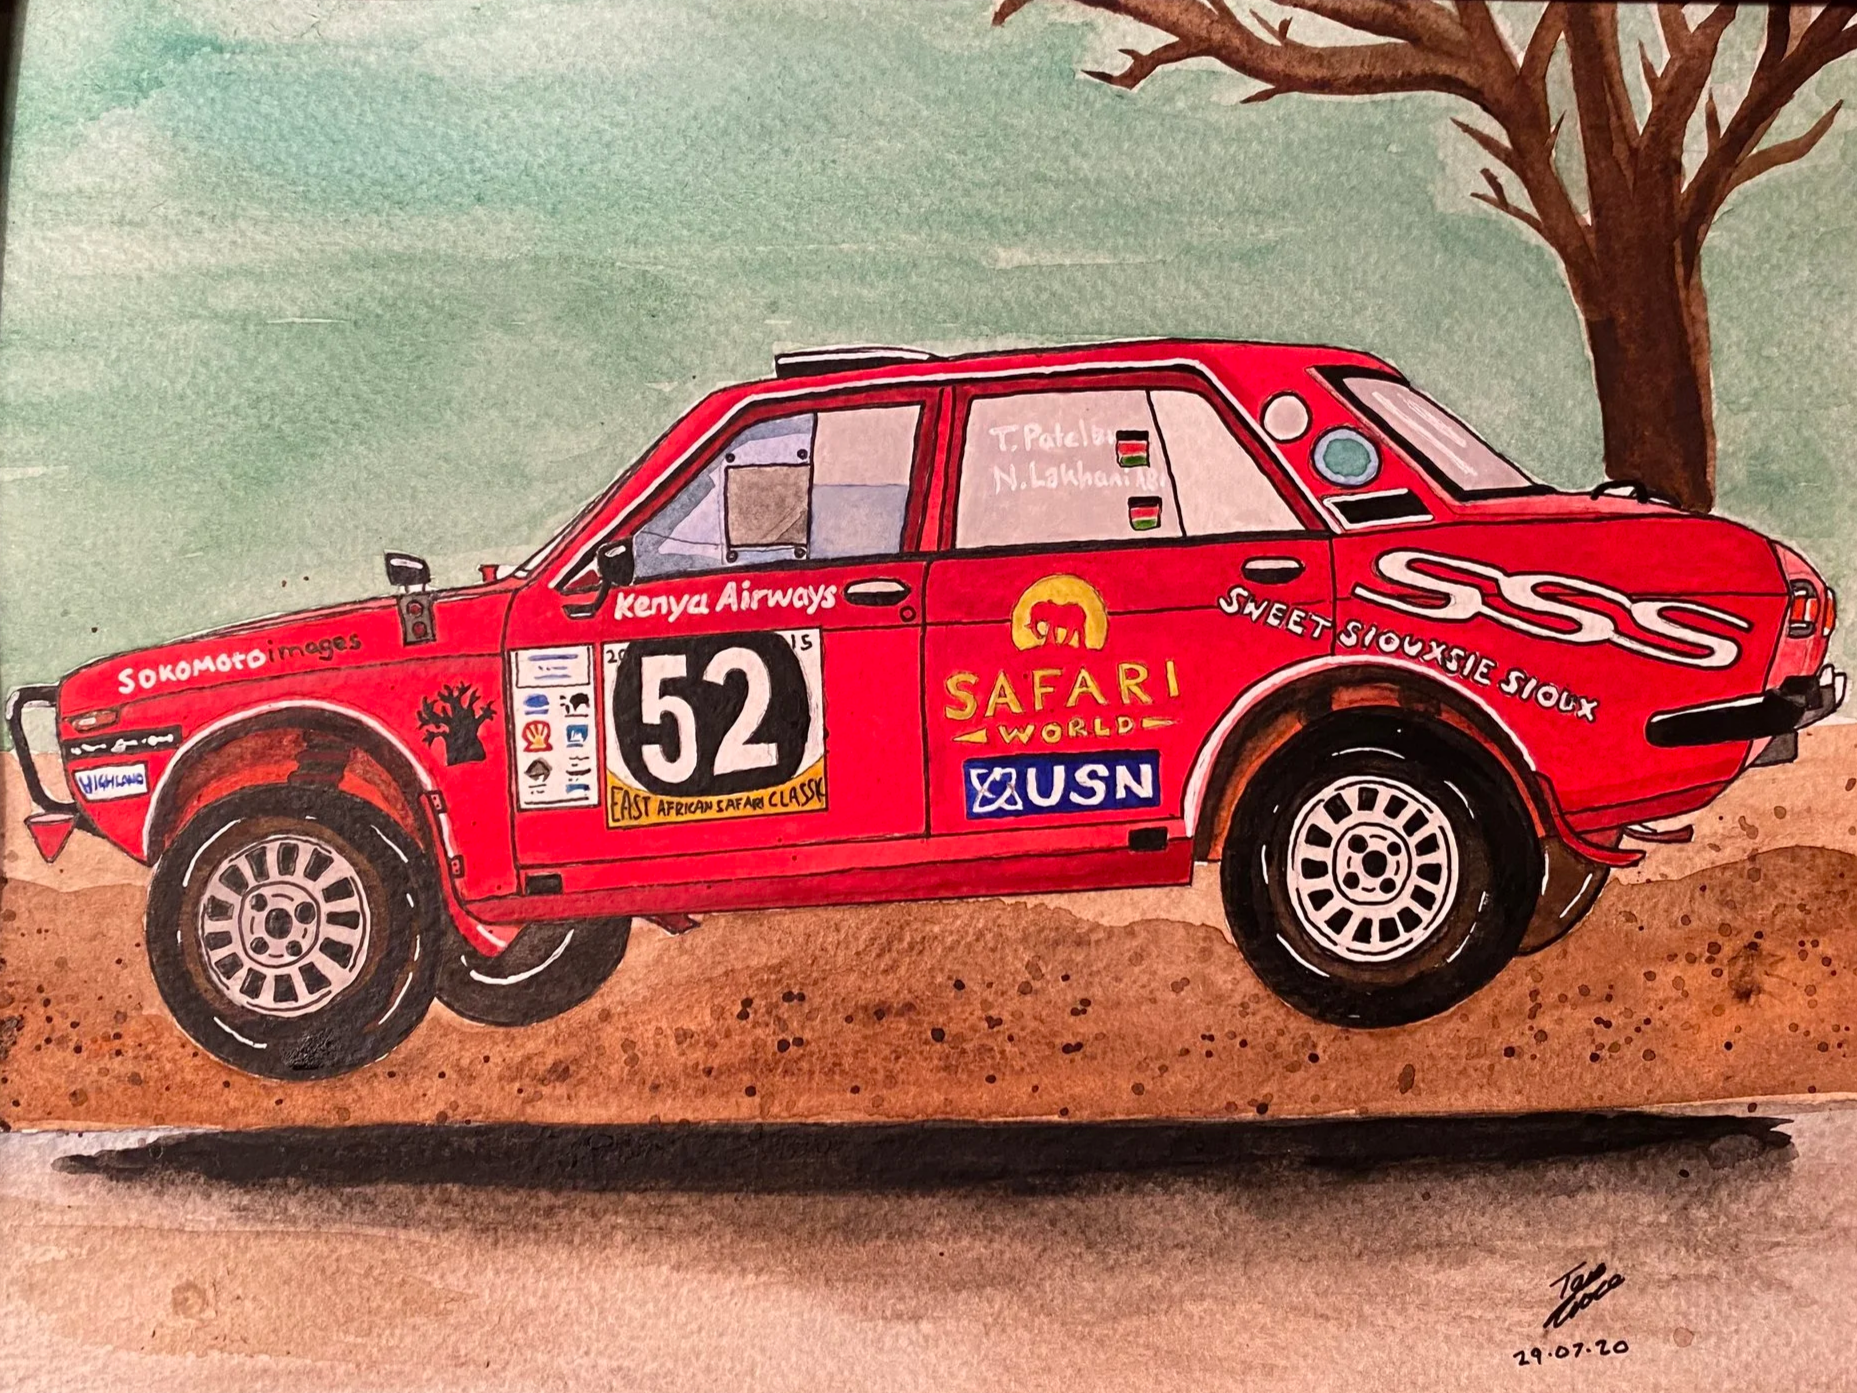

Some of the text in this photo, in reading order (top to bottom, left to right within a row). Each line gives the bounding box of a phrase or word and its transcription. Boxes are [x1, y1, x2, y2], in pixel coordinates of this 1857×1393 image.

[1023, 419, 1088, 452] Patel
[992, 463, 1027, 495] N.
[614, 580, 837, 622] Kenya Airways
[1353, 550, 1751, 669] SSS
[1219, 587, 1599, 722] SWEET SIOUXSIE SIOUX
[945, 658, 1180, 721] SAFARI
[641, 647, 778, 783] 52
[999, 715, 1135, 744] WORLD
[610, 786, 651, 823] EAST
[657, 799, 714, 817] AFRICAN
[1026, 763, 1154, 807] USN
